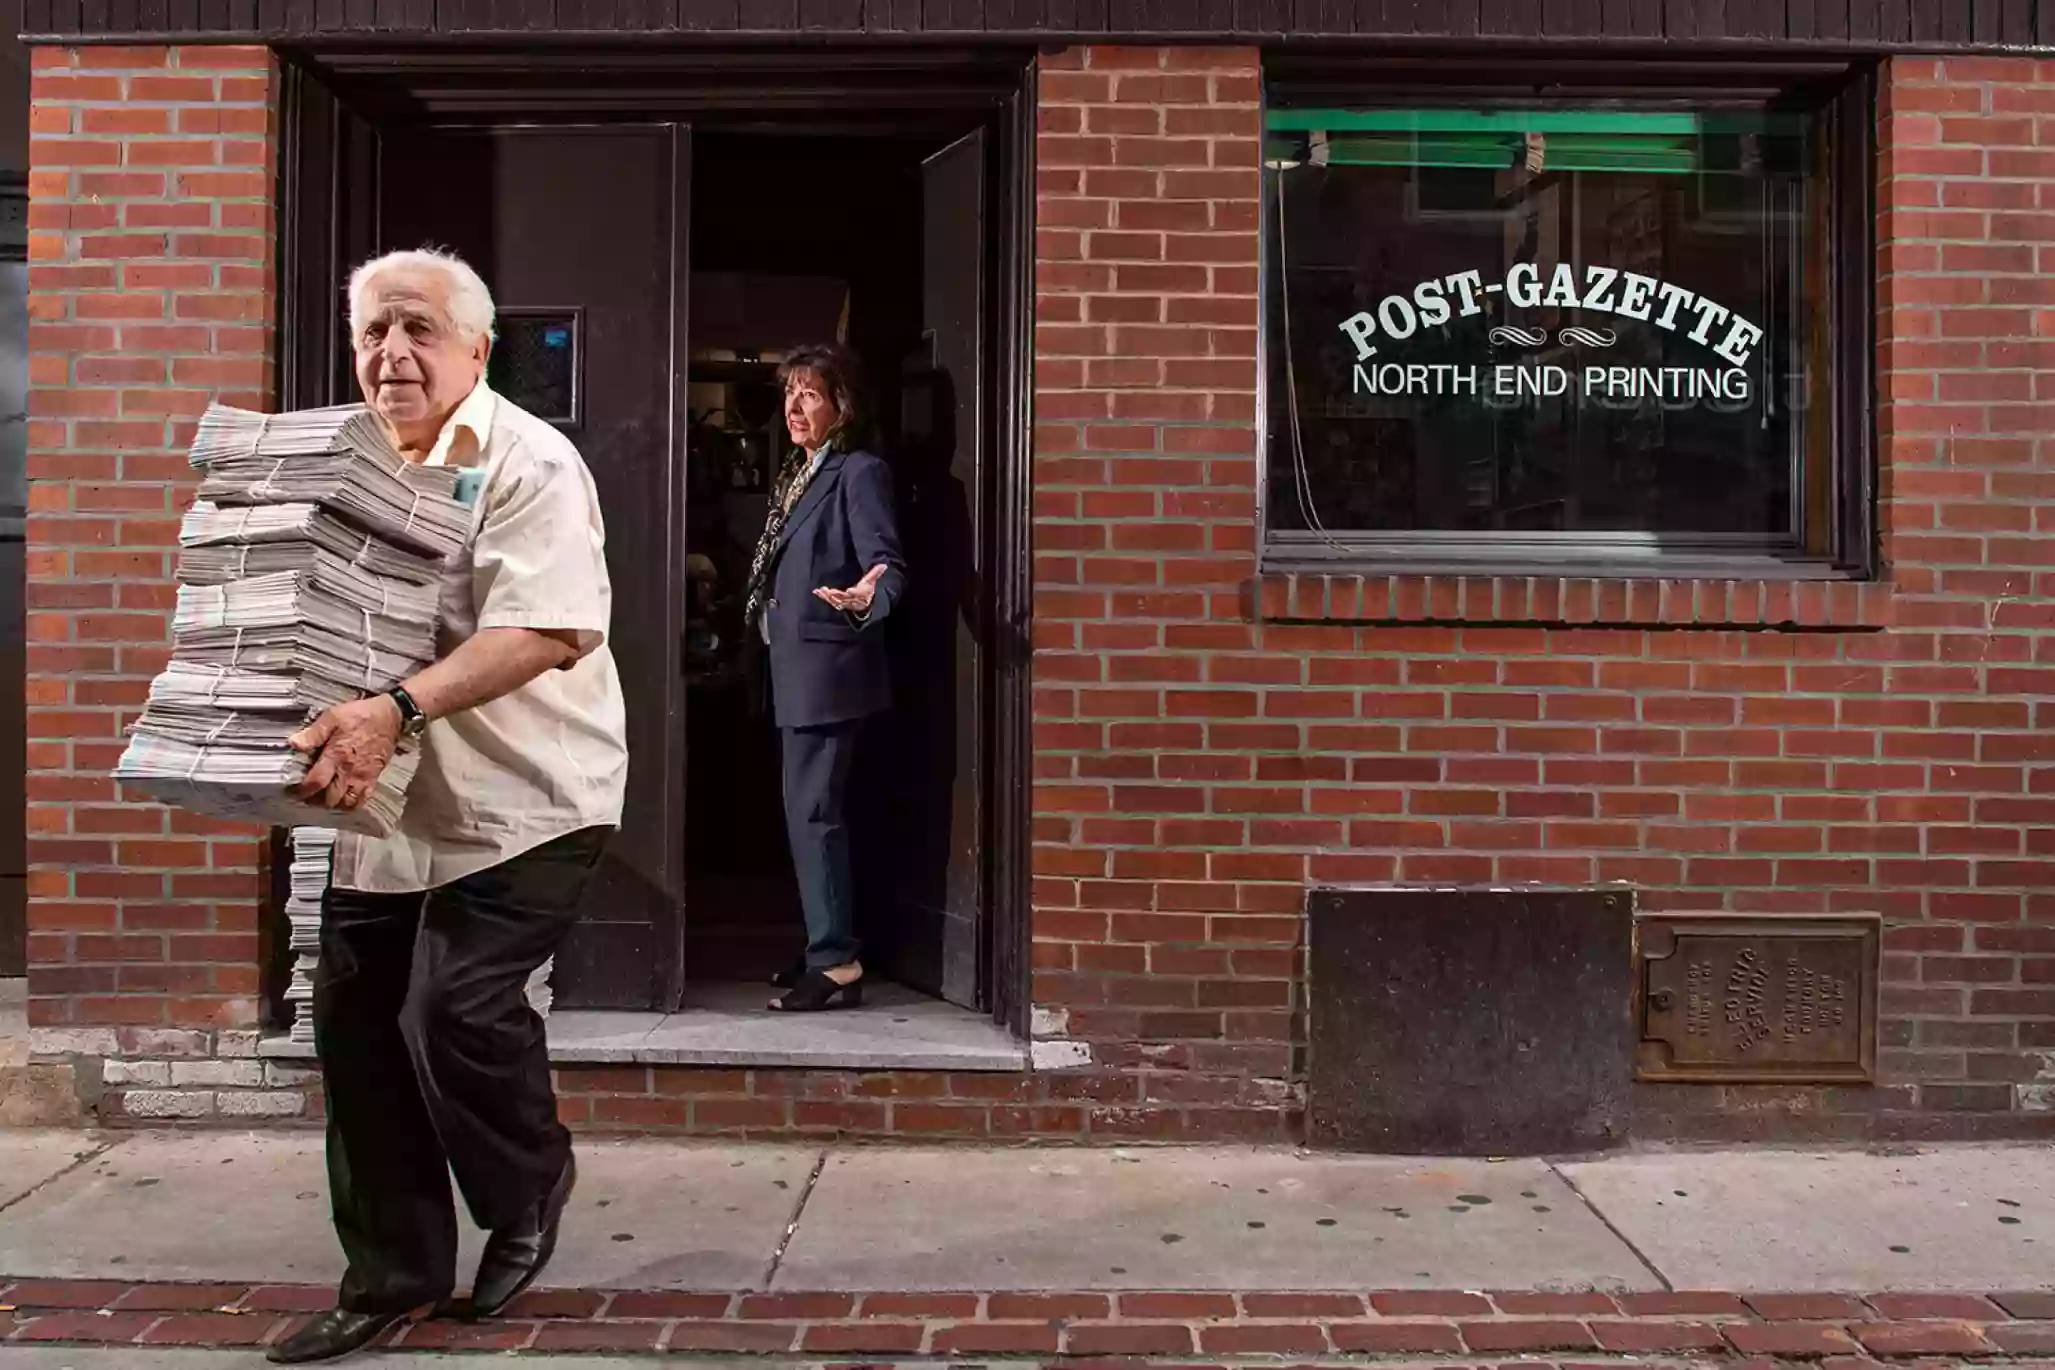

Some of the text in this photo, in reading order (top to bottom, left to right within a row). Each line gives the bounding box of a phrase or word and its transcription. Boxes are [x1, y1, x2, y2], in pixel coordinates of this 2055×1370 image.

[1338, 263, 1763, 368] POST-GAZETTE
[1353, 363, 1477, 395] NORTH
[1494, 365, 1568, 396] END
[1585, 366, 1748, 399] PRINTING
